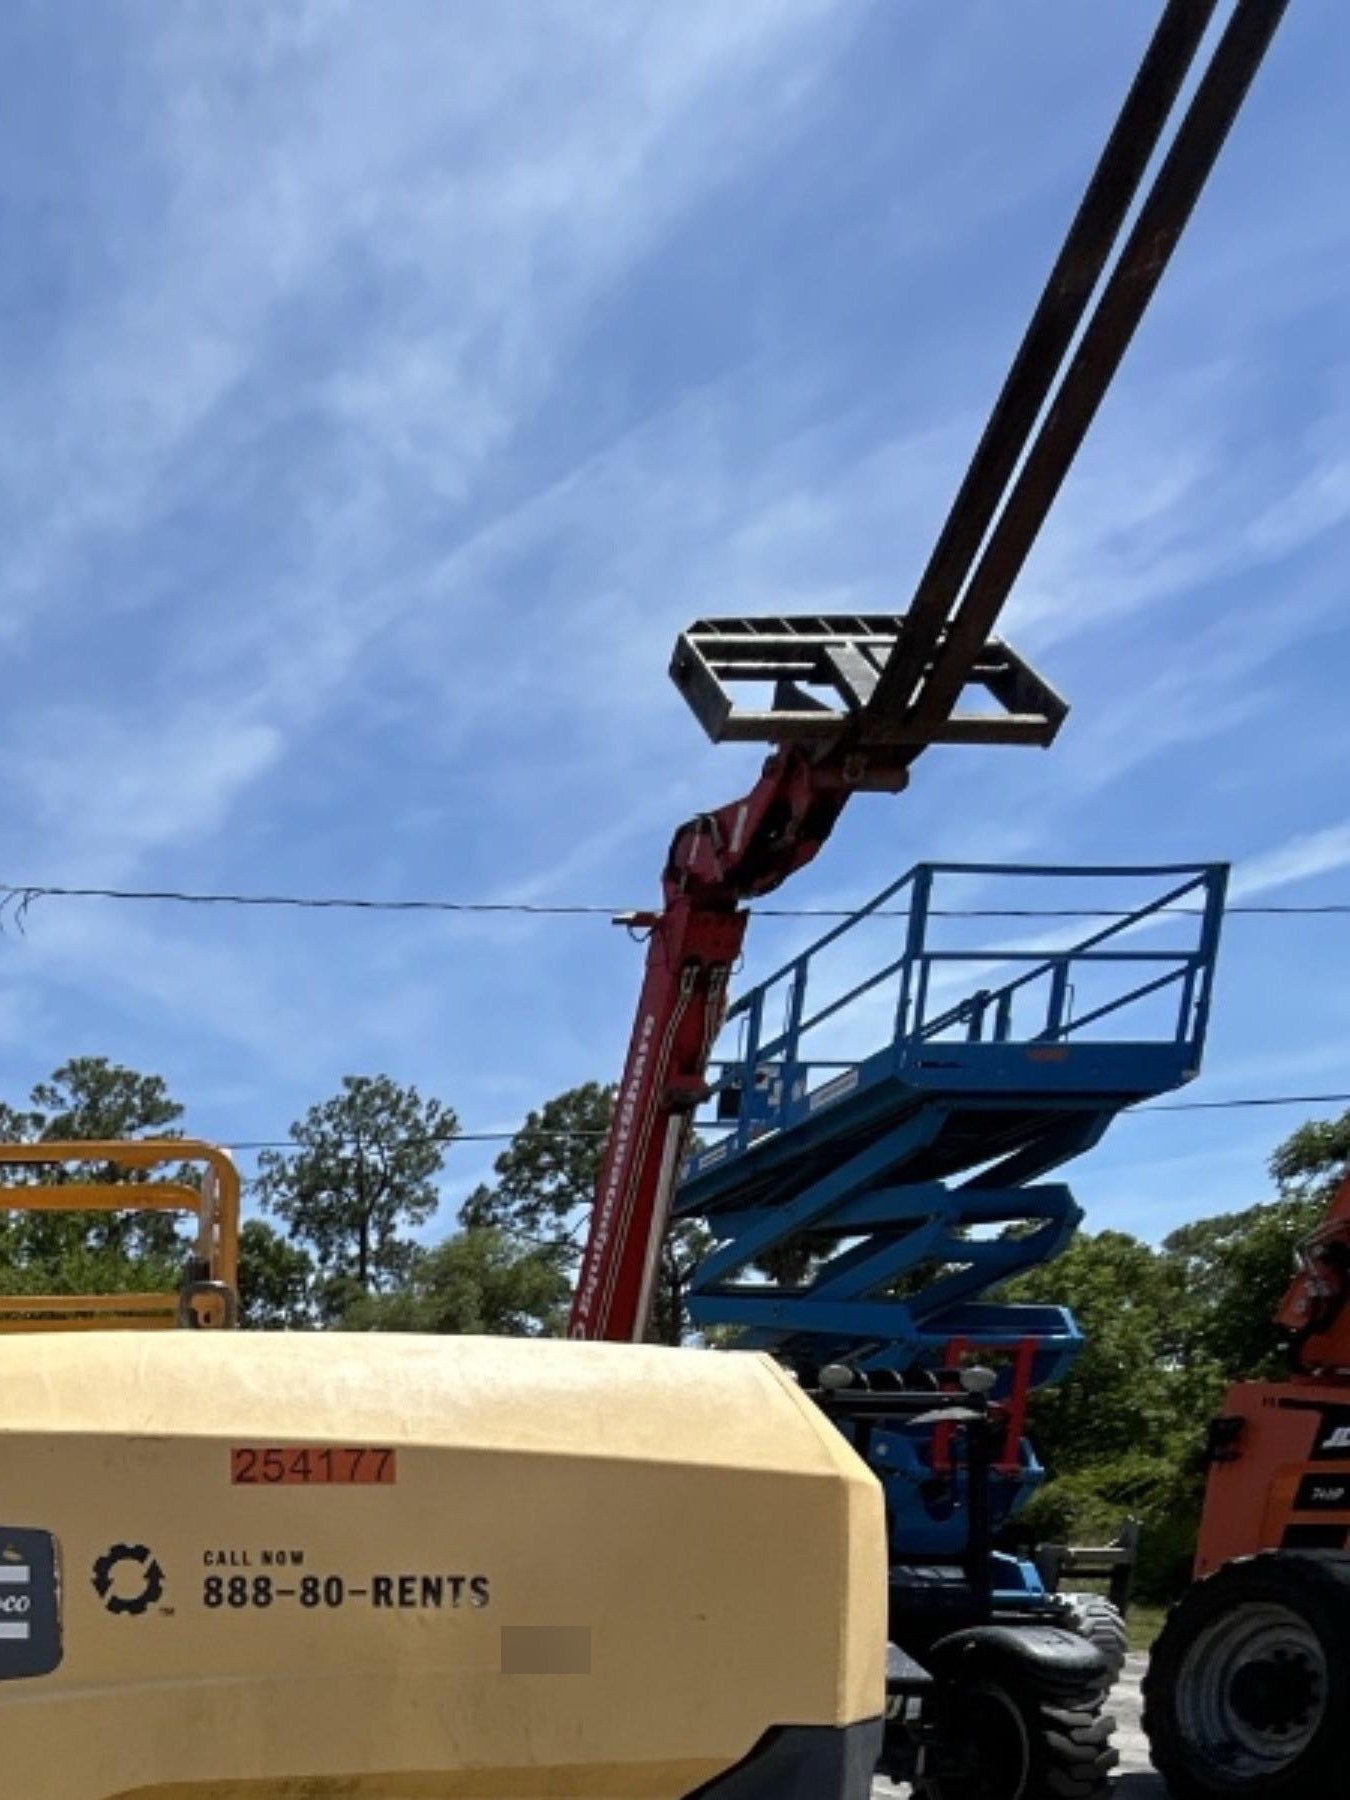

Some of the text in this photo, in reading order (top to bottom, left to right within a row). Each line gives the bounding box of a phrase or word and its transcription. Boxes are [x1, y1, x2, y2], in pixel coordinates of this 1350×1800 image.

[235, 1449, 393, 1483] 254177
[203, 1551, 304, 1566] CALL NOW
[203, 1576, 490, 1608] 888-80-RENTS
